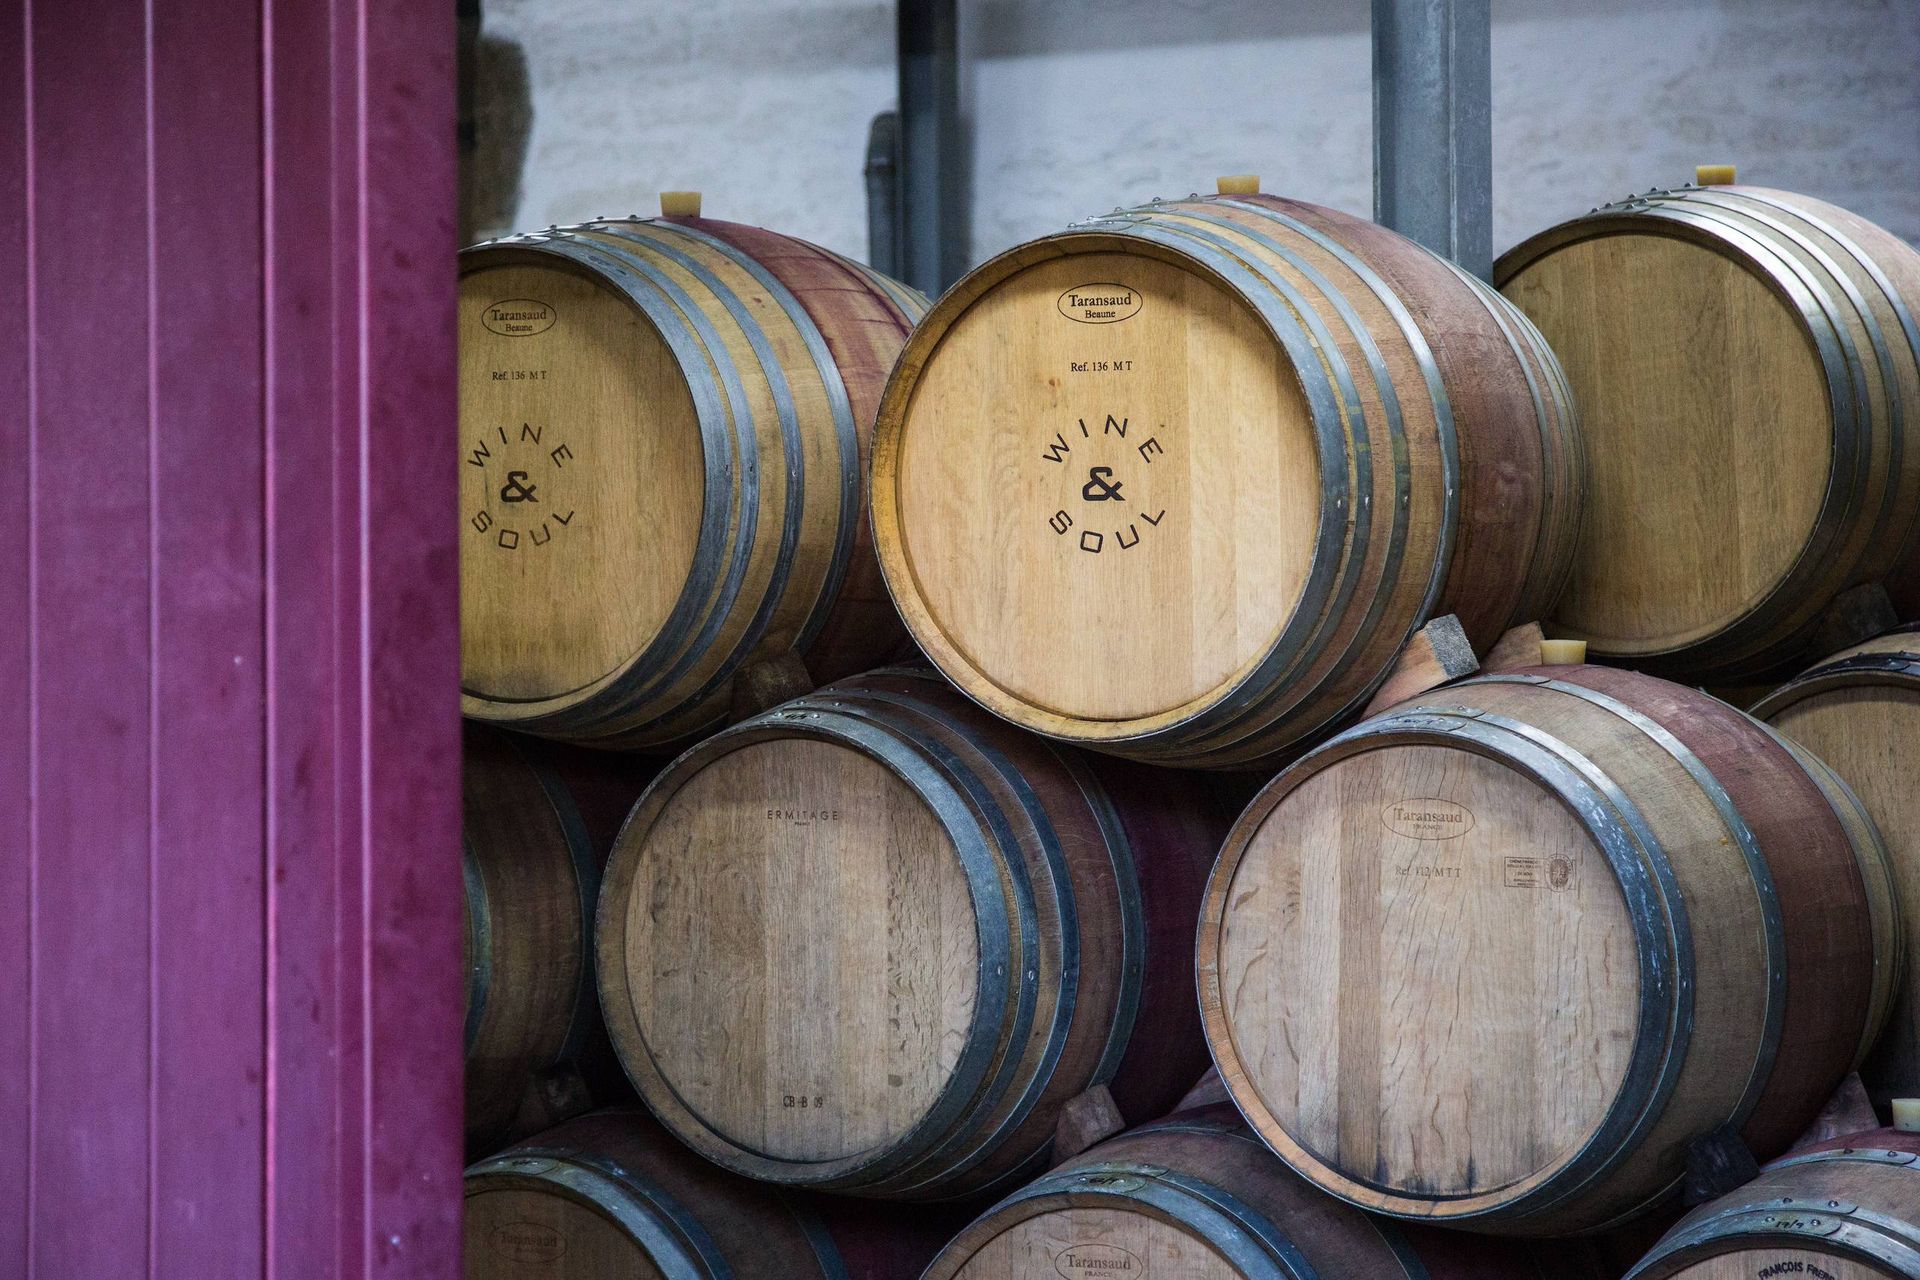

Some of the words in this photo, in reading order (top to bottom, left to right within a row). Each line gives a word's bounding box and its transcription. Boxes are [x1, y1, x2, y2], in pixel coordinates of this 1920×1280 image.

[1068, 293, 1132, 307] Taransaud
[491, 309, 547, 321] Taransaud
[1084, 310, 1116, 319] Beaune
[505, 323, 533, 332] Beaune
[1071, 361, 1089, 372] Ref.
[1092, 361, 1109, 372] 136
[466, 422, 574, 468] WINE
[1042, 414, 1164, 464] WINE
[501, 471, 539, 503] &
[1082, 466, 1126, 502] &
[471, 510, 575, 550] SOUL
[1048, 509, 1166, 554] SOUL
[767, 810, 838, 821] ERMITAGE
[1393, 808, 1463, 823] Taransaud
[783, 1095, 795, 1108] CB
[1065, 1254, 1131, 1270] Taransaud
